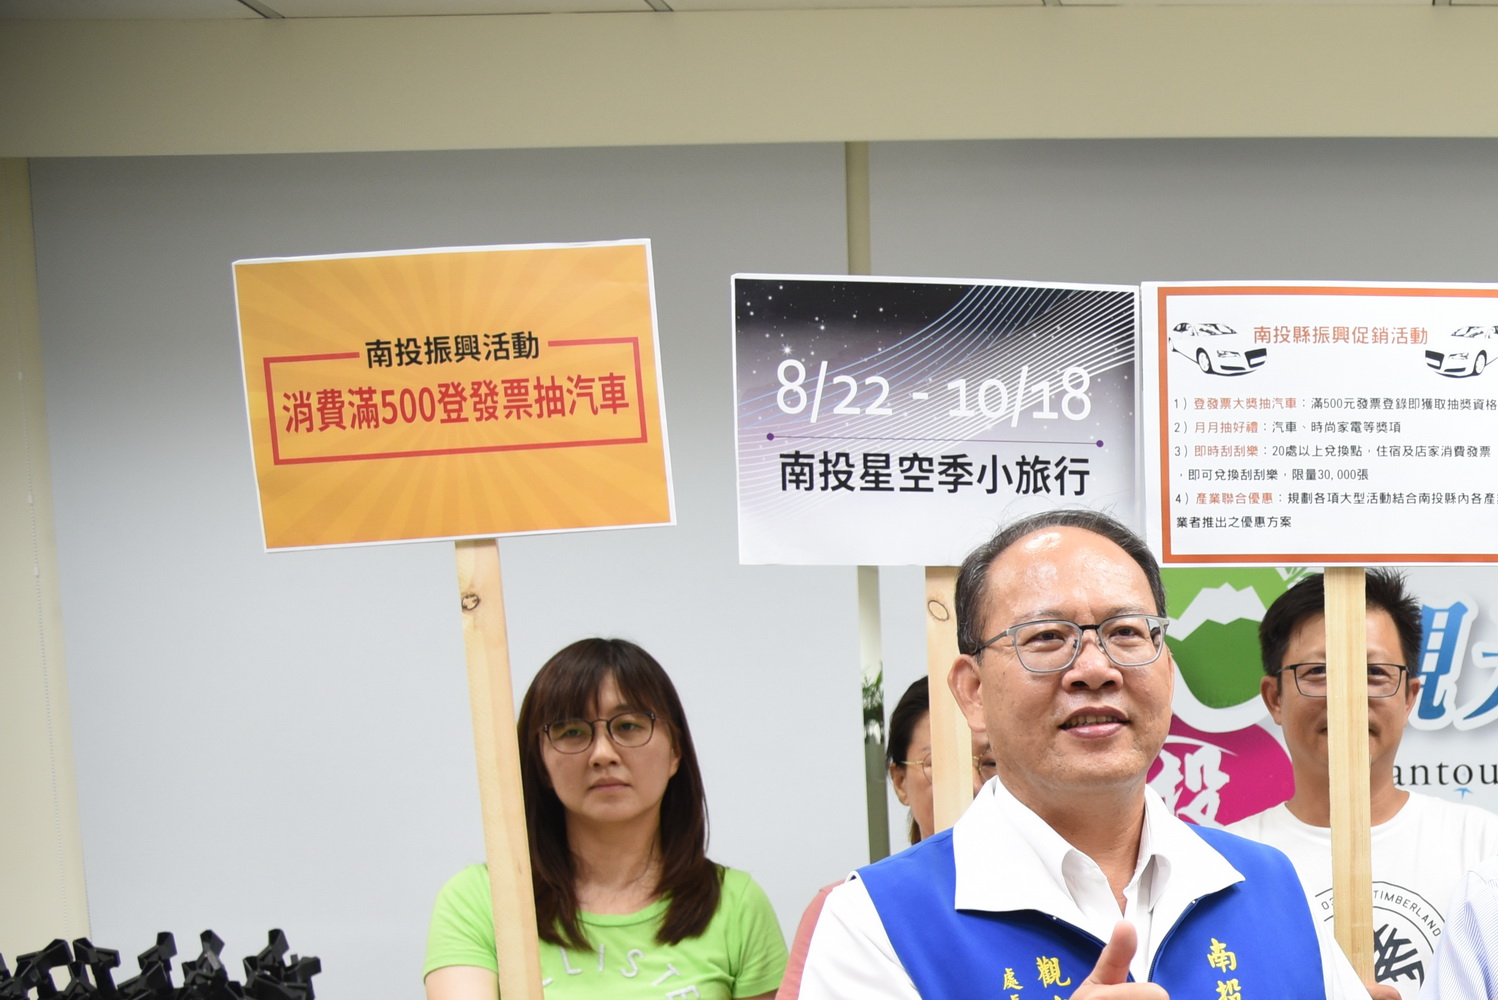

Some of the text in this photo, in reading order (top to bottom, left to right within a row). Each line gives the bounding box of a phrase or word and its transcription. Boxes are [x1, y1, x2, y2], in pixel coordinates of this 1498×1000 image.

[365, 331, 540, 369] 南投振興活動
[1253, 325, 1429, 346] 南投縣振興促銷活動
[282, 372, 630, 433] 消費滿500登發票抽汽車
[776, 359, 893, 424] 8/22
[947, 365, 1092, 428] 10/18
[778, 450, 1091, 496] 南投星空季小旅行
[1176, 515, 1293, 529] 業者推出之優惠方案
[1373, 889, 1442, 937] TIMBERLAND
